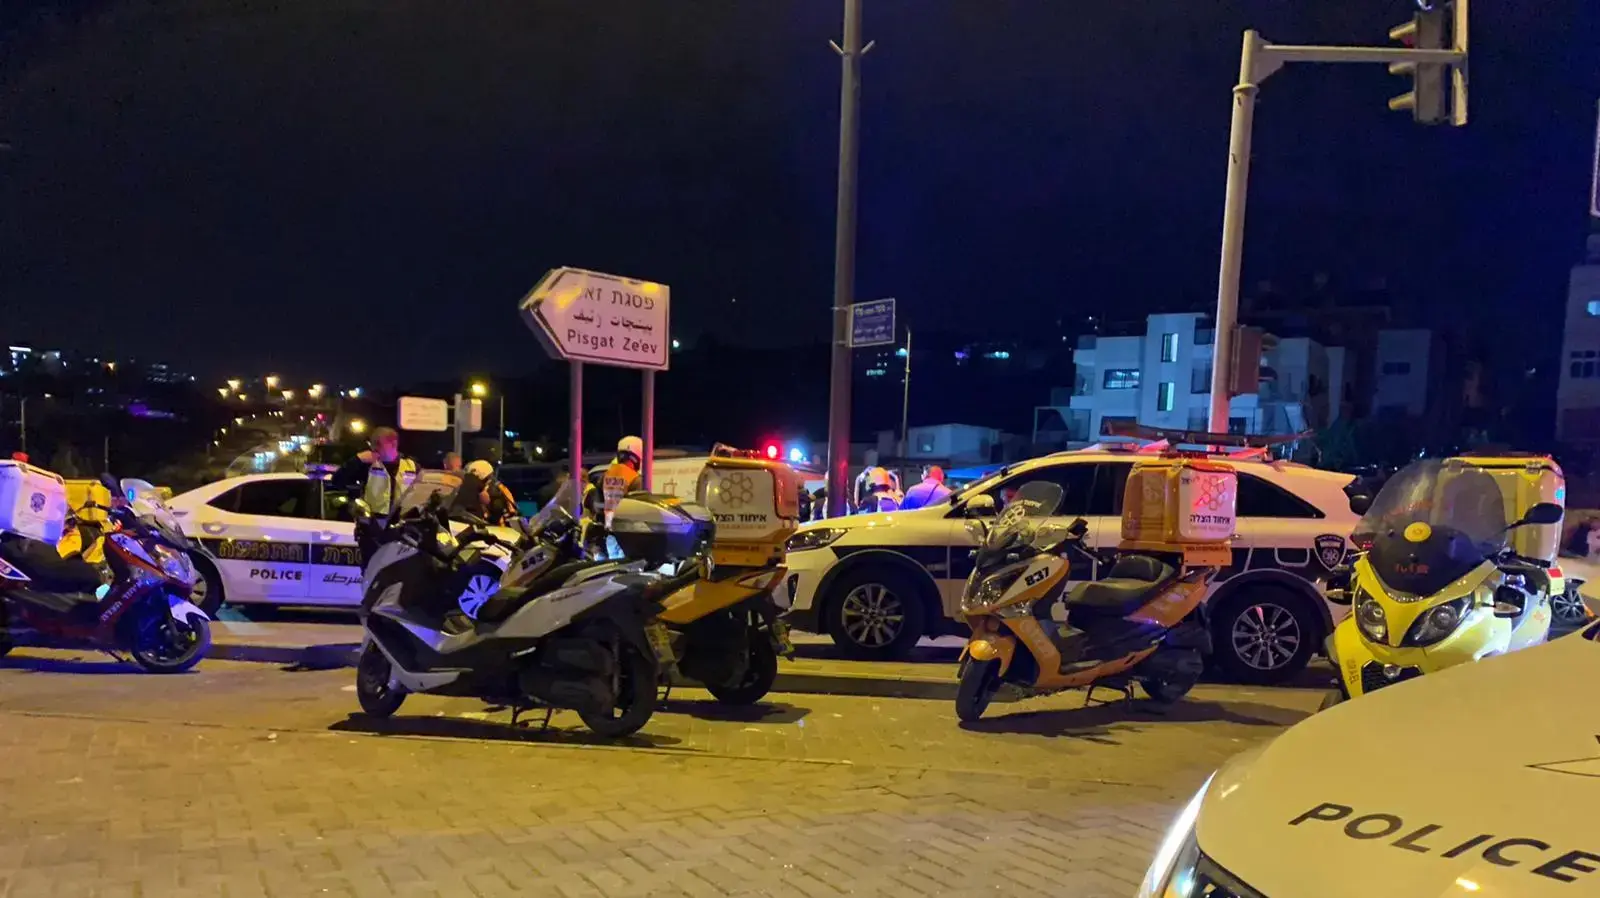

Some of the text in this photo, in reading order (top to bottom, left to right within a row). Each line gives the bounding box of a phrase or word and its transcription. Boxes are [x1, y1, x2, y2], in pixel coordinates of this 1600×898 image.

[611, 289, 655, 310] פסגת
[567, 328, 657, 354] Pisgat Ze'ev
[713, 512, 767, 522] איחוד הצל
[1190, 513, 1211, 523] הצלה
[250, 568, 303, 581] POLICE
[1024, 567, 1049, 586] 837
[1288, 802, 1600, 883] POLICE
